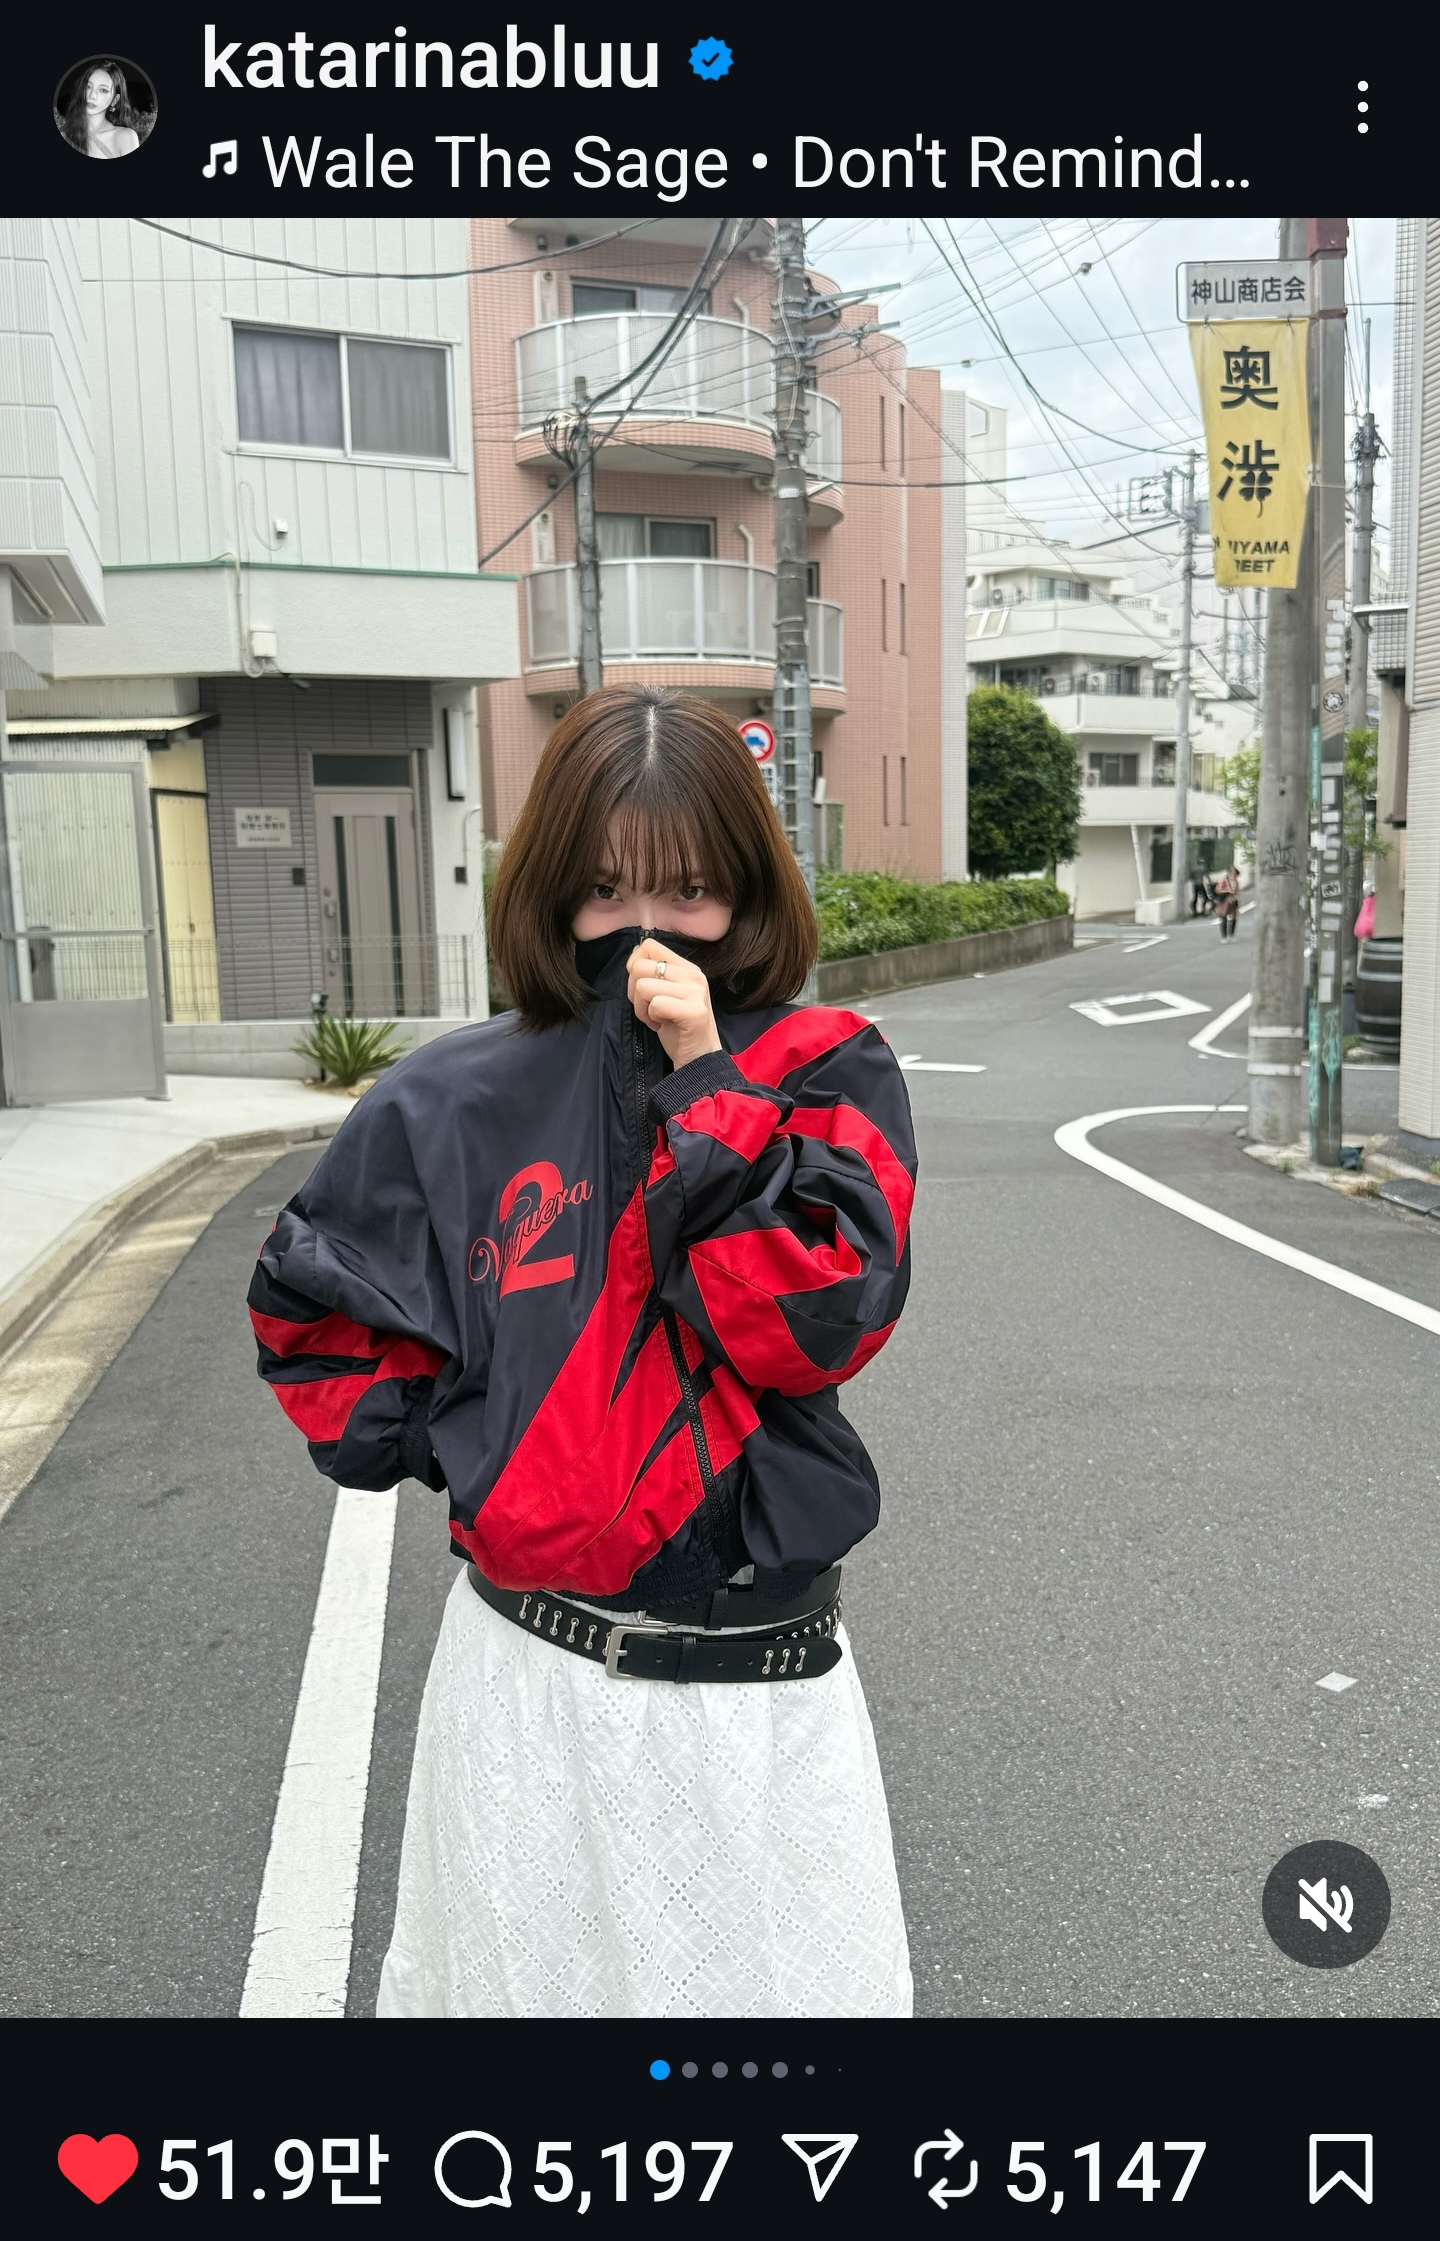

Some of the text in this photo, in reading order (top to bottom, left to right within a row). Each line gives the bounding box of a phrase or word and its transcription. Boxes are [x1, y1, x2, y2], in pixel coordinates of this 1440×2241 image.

[1190, 275, 1306, 305] 神山商店会
[497, 1160, 576, 1302] 2
